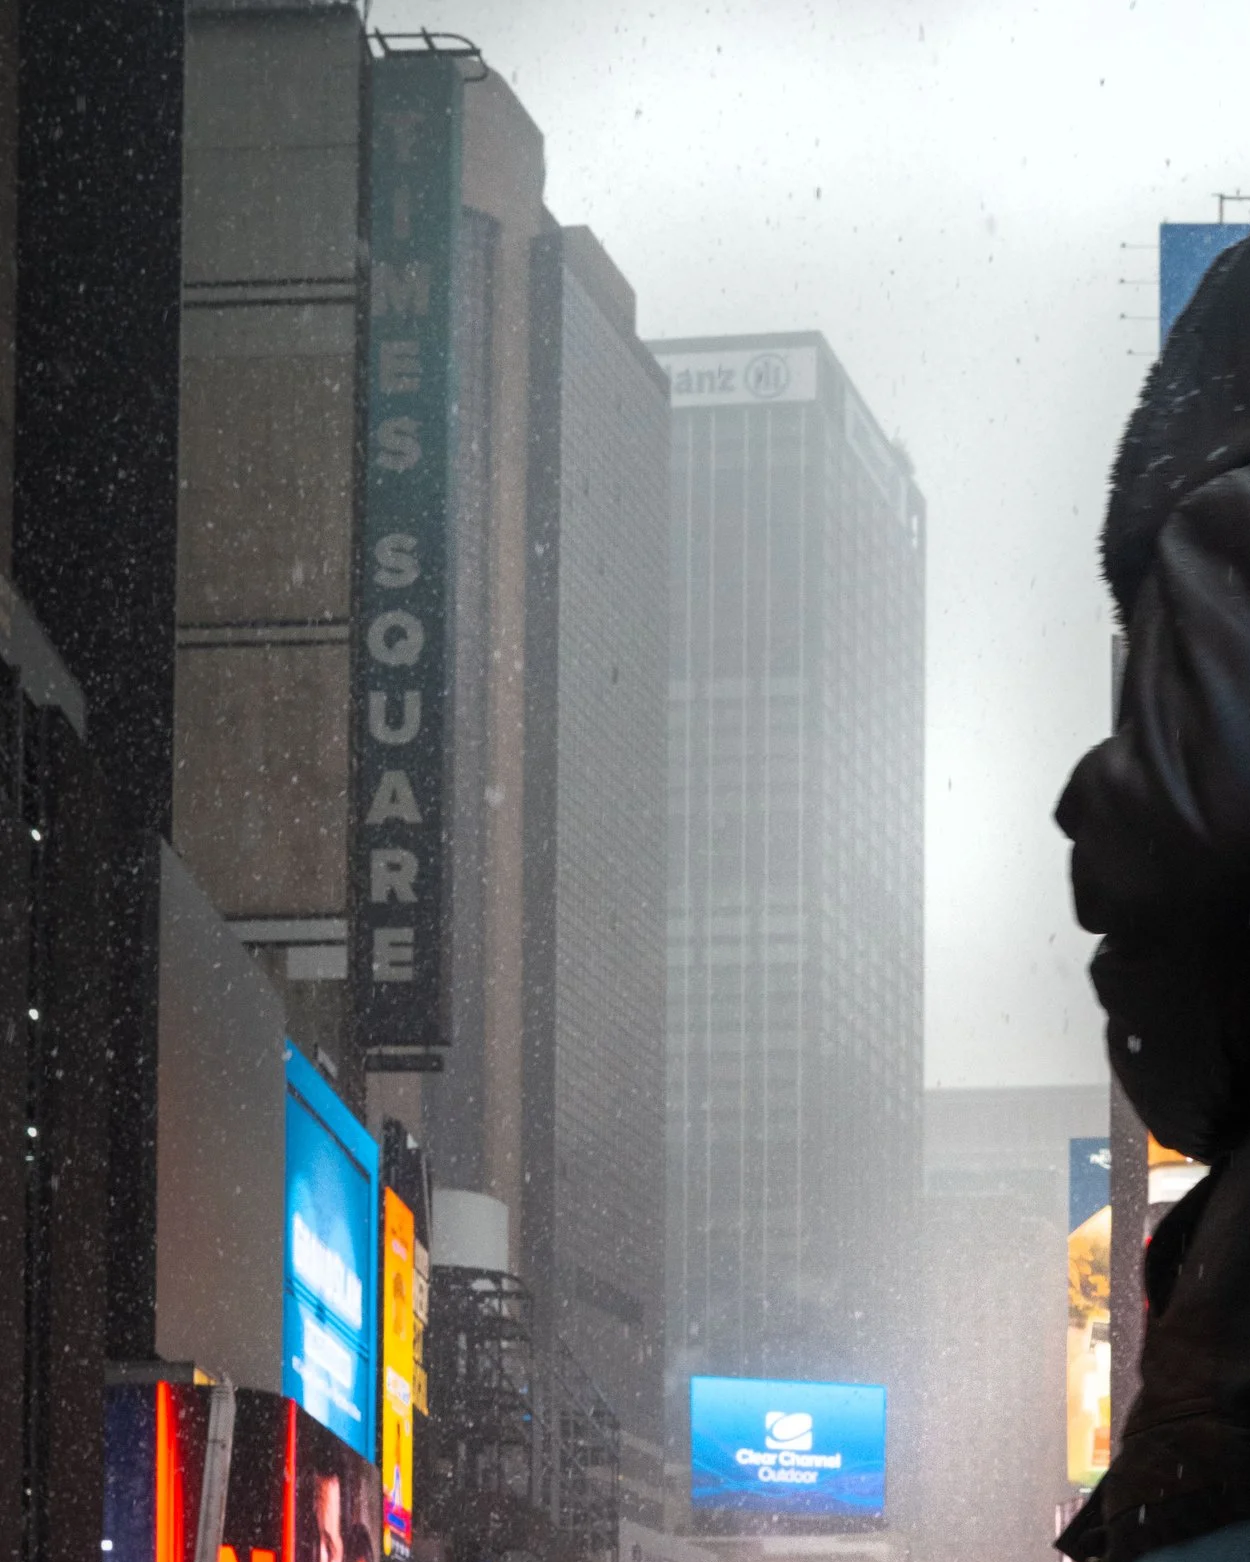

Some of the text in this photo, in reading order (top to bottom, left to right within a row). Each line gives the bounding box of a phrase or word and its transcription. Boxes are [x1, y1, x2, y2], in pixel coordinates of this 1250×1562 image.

[366, 111, 430, 982] TIMES SQUARE
[736, 1448, 842, 1469] Clear Channel
[758, 1466, 818, 1484] Outdoor
